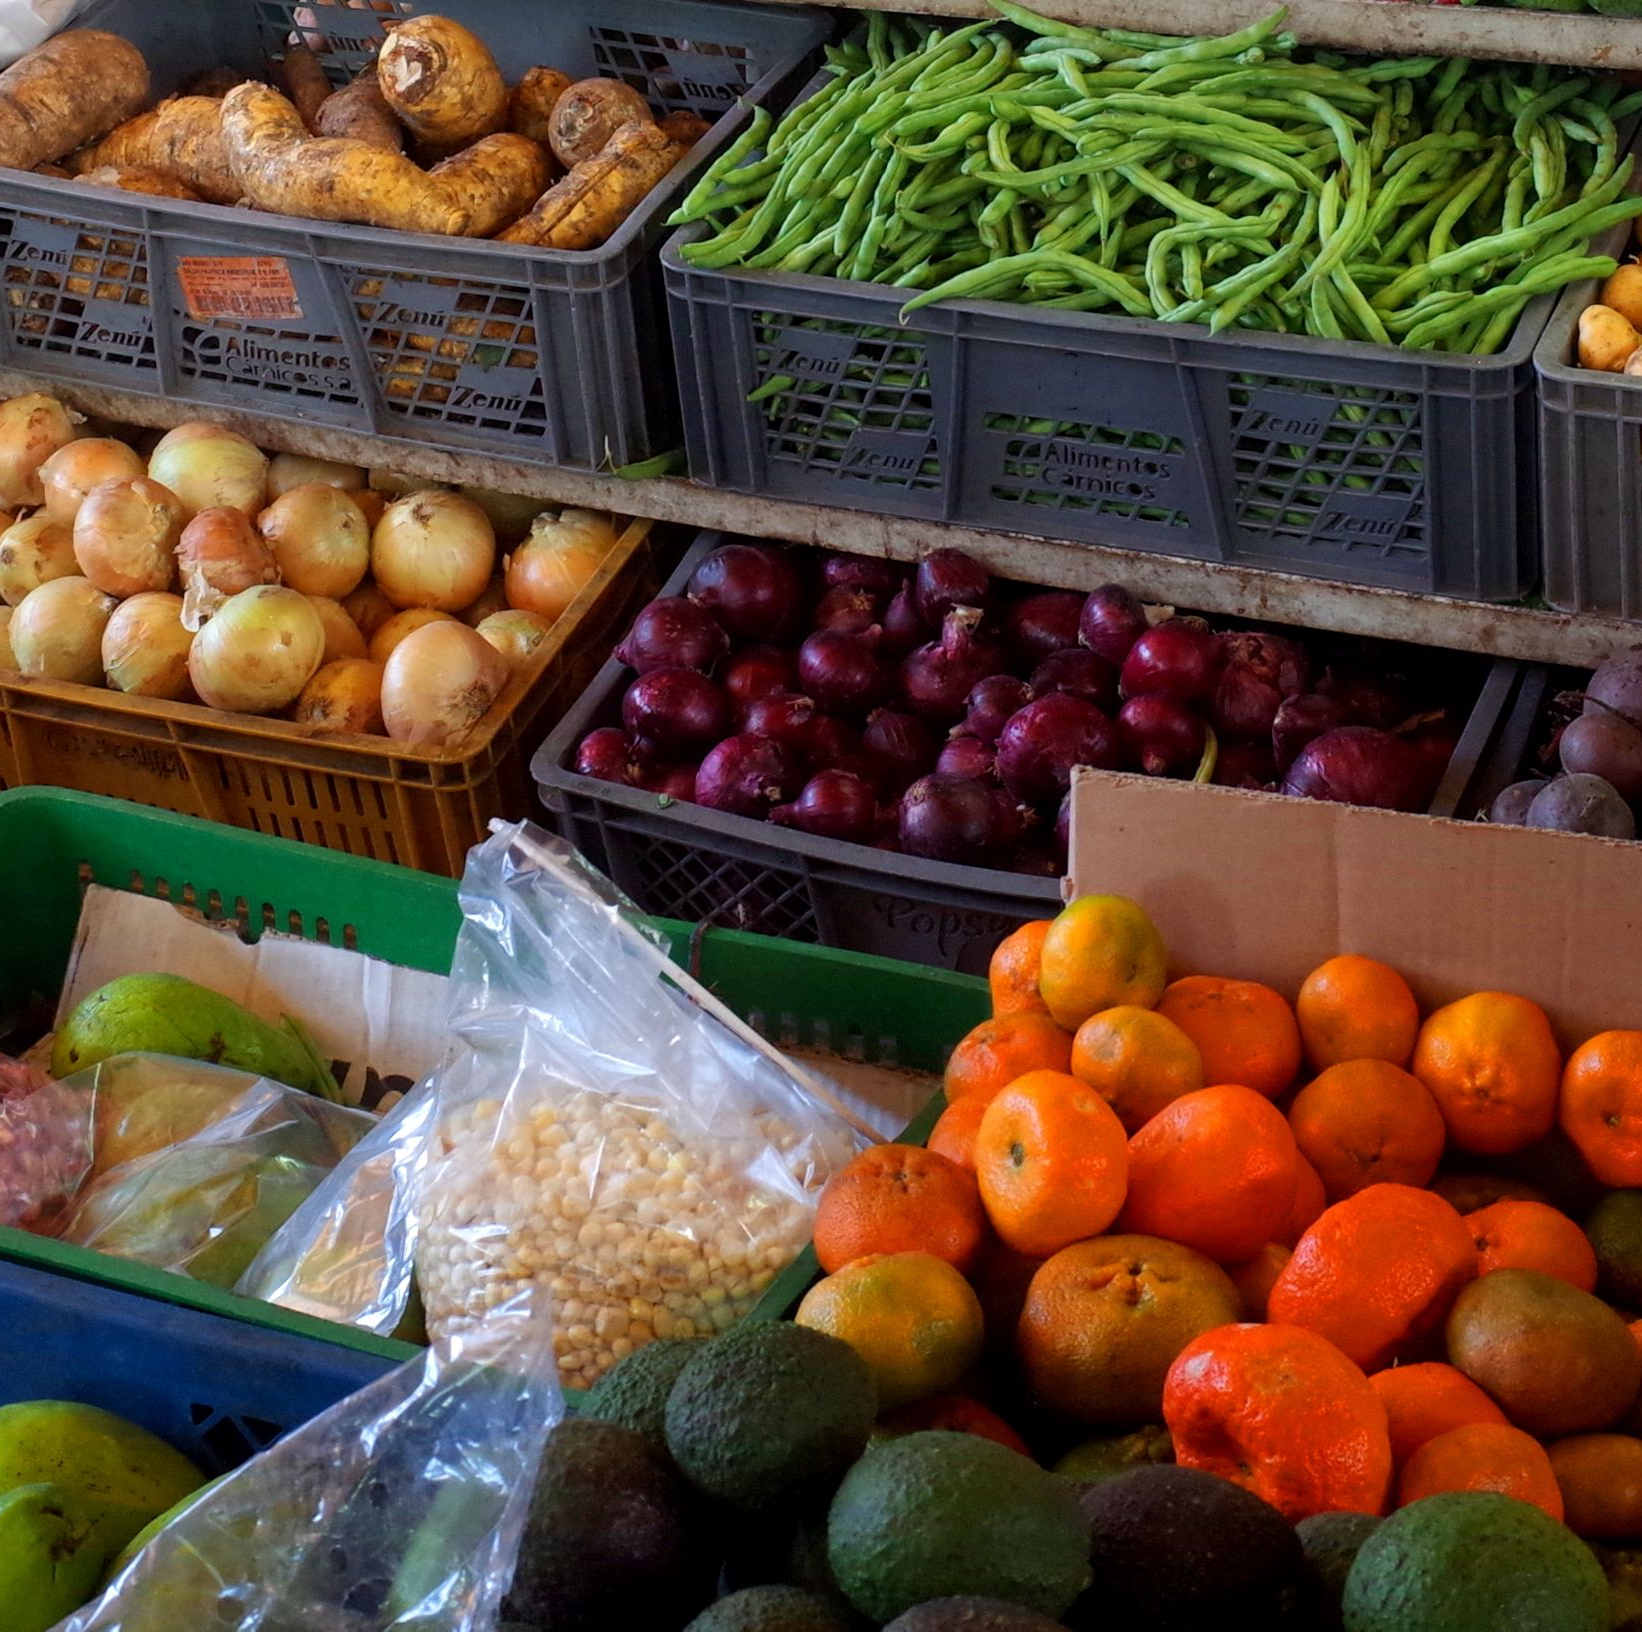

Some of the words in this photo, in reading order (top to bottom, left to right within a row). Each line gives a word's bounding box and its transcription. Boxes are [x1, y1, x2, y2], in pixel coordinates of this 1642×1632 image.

[10, 238, 69, 266] Zenú
[377, 302, 446, 328] Zenú
[79, 320, 143, 348] Zenú
[225, 336, 351, 372] Alimentos
[777, 348, 841, 375] Zenú
[226, 355, 319, 385] Cárnicos
[452, 385, 525, 412] Zenú
[1245, 410, 1320, 437] Zenú
[1044, 441, 1172, 480] Alimentos
[1042, 467, 1158, 503] Cárnicos
